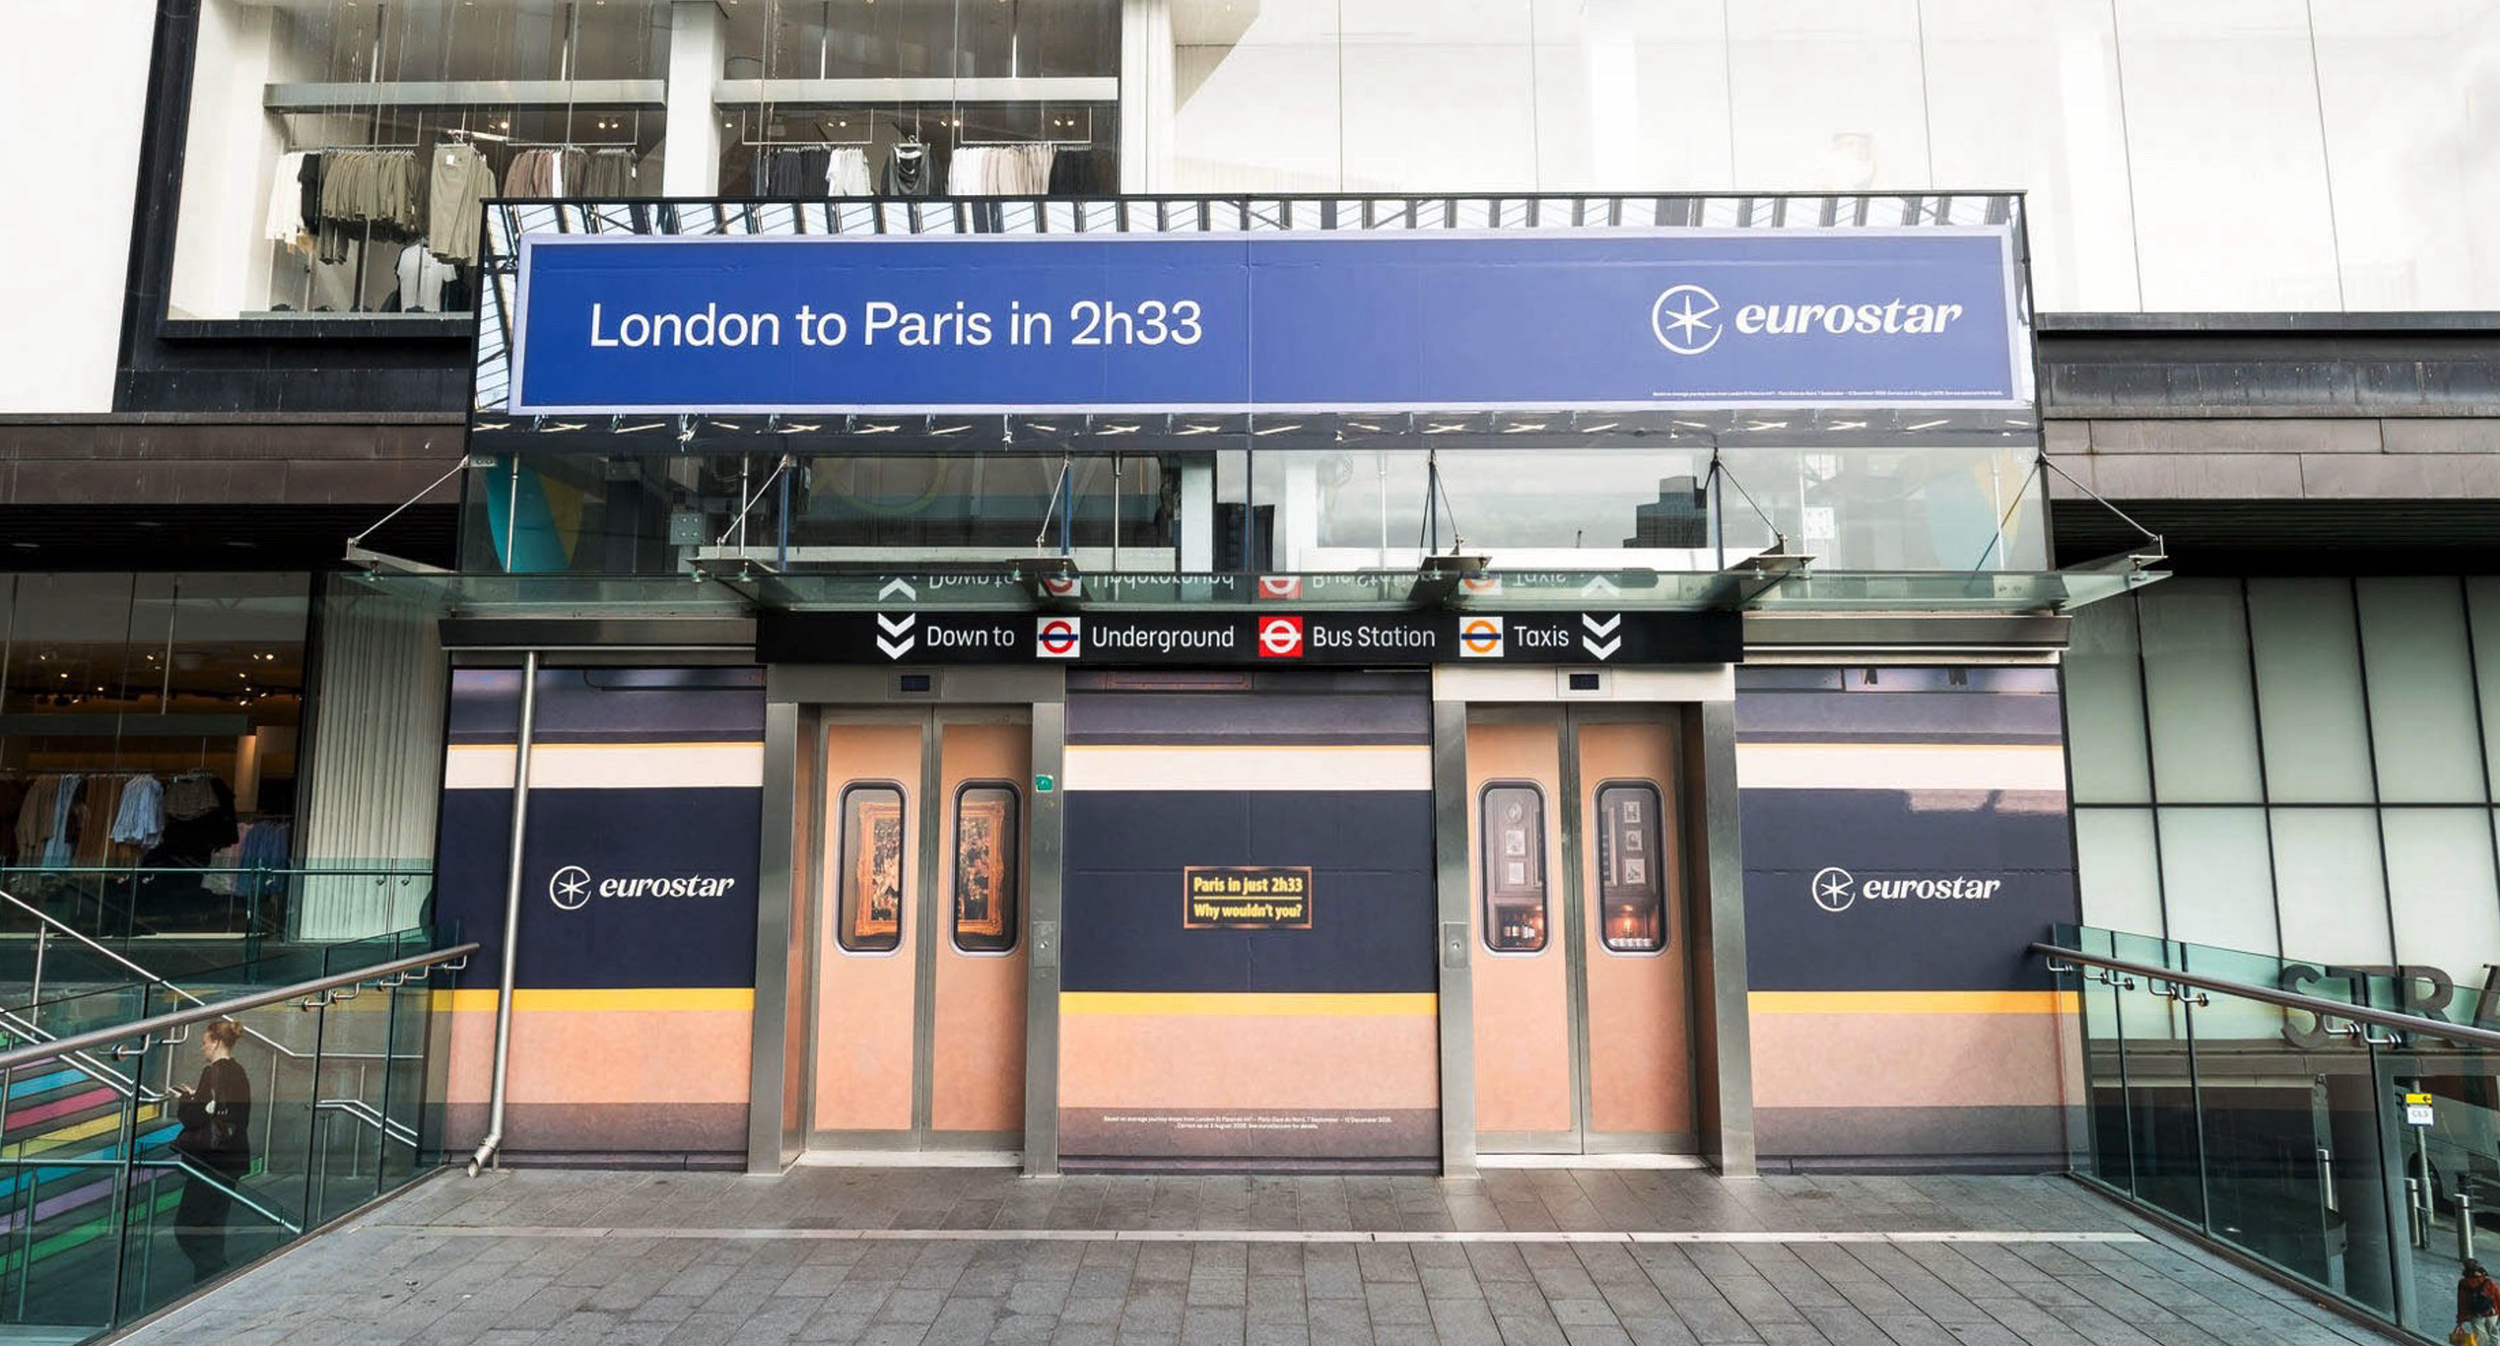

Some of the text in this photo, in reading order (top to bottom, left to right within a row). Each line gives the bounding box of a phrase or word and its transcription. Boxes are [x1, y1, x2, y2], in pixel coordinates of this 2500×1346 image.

[590, 300, 1203, 347] London to Paris in 2h33
[1735, 298, 1963, 334] eurostar
[926, 626, 1015, 647] Down to
[1092, 625, 1235, 653] Underground
[1313, 626, 1436, 648] Bus Station
[1514, 625, 1570, 647] Taxis
[599, 874, 735, 898] eurostar
[1193, 876, 1303, 895] Paris in just 2h33
[1862, 876, 2001, 900] eurostar
[1193, 903, 1303, 921] Why wouldn't you?
